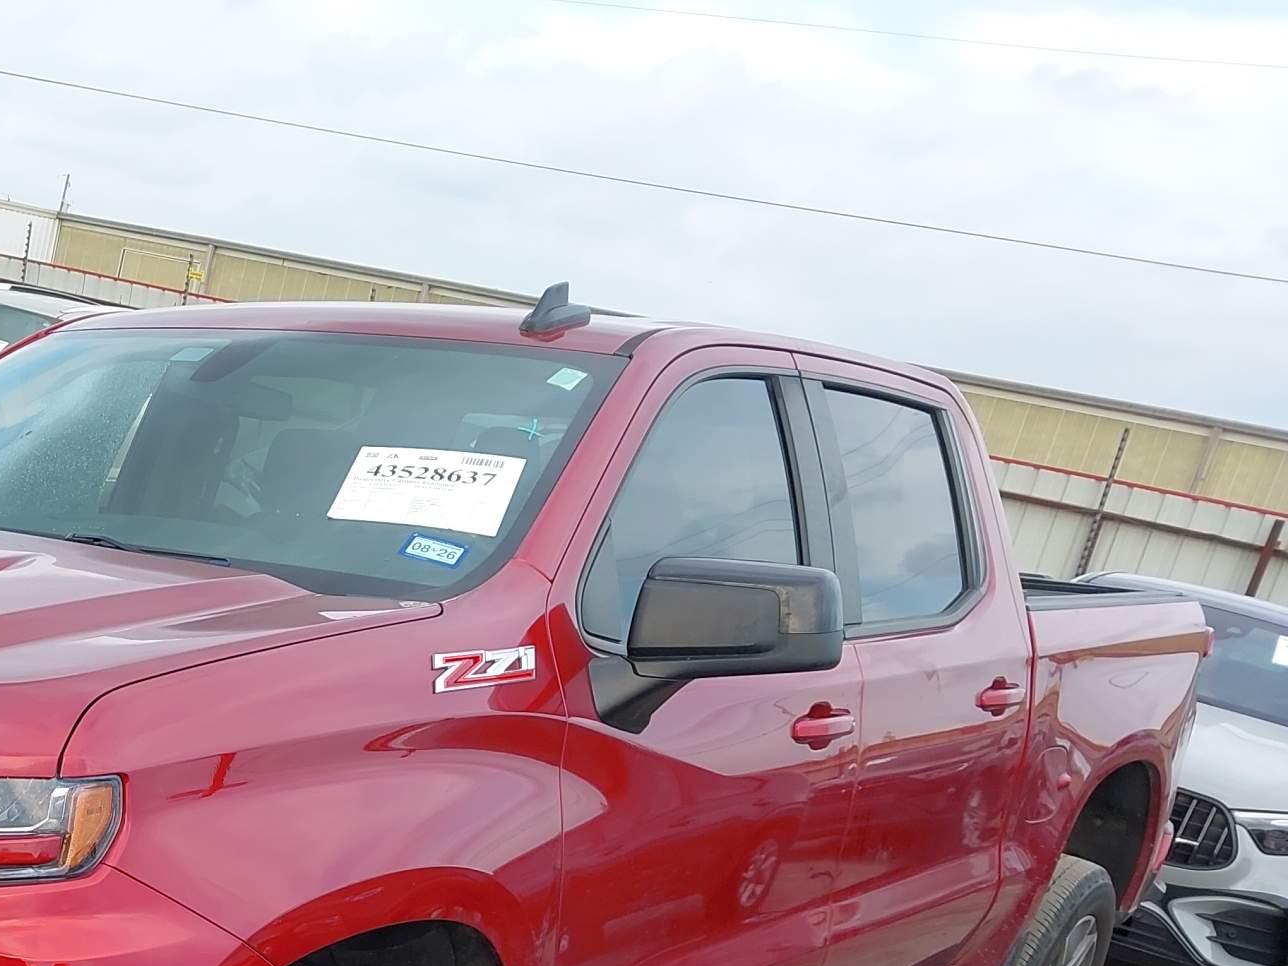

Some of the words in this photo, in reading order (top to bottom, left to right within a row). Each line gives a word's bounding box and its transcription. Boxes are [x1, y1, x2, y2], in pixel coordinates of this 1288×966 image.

[366, 463, 497, 487] 43528637
[412, 541, 432, 554] 08
[437, 549, 458, 560] 26
[431, 645, 536, 693] Z71
